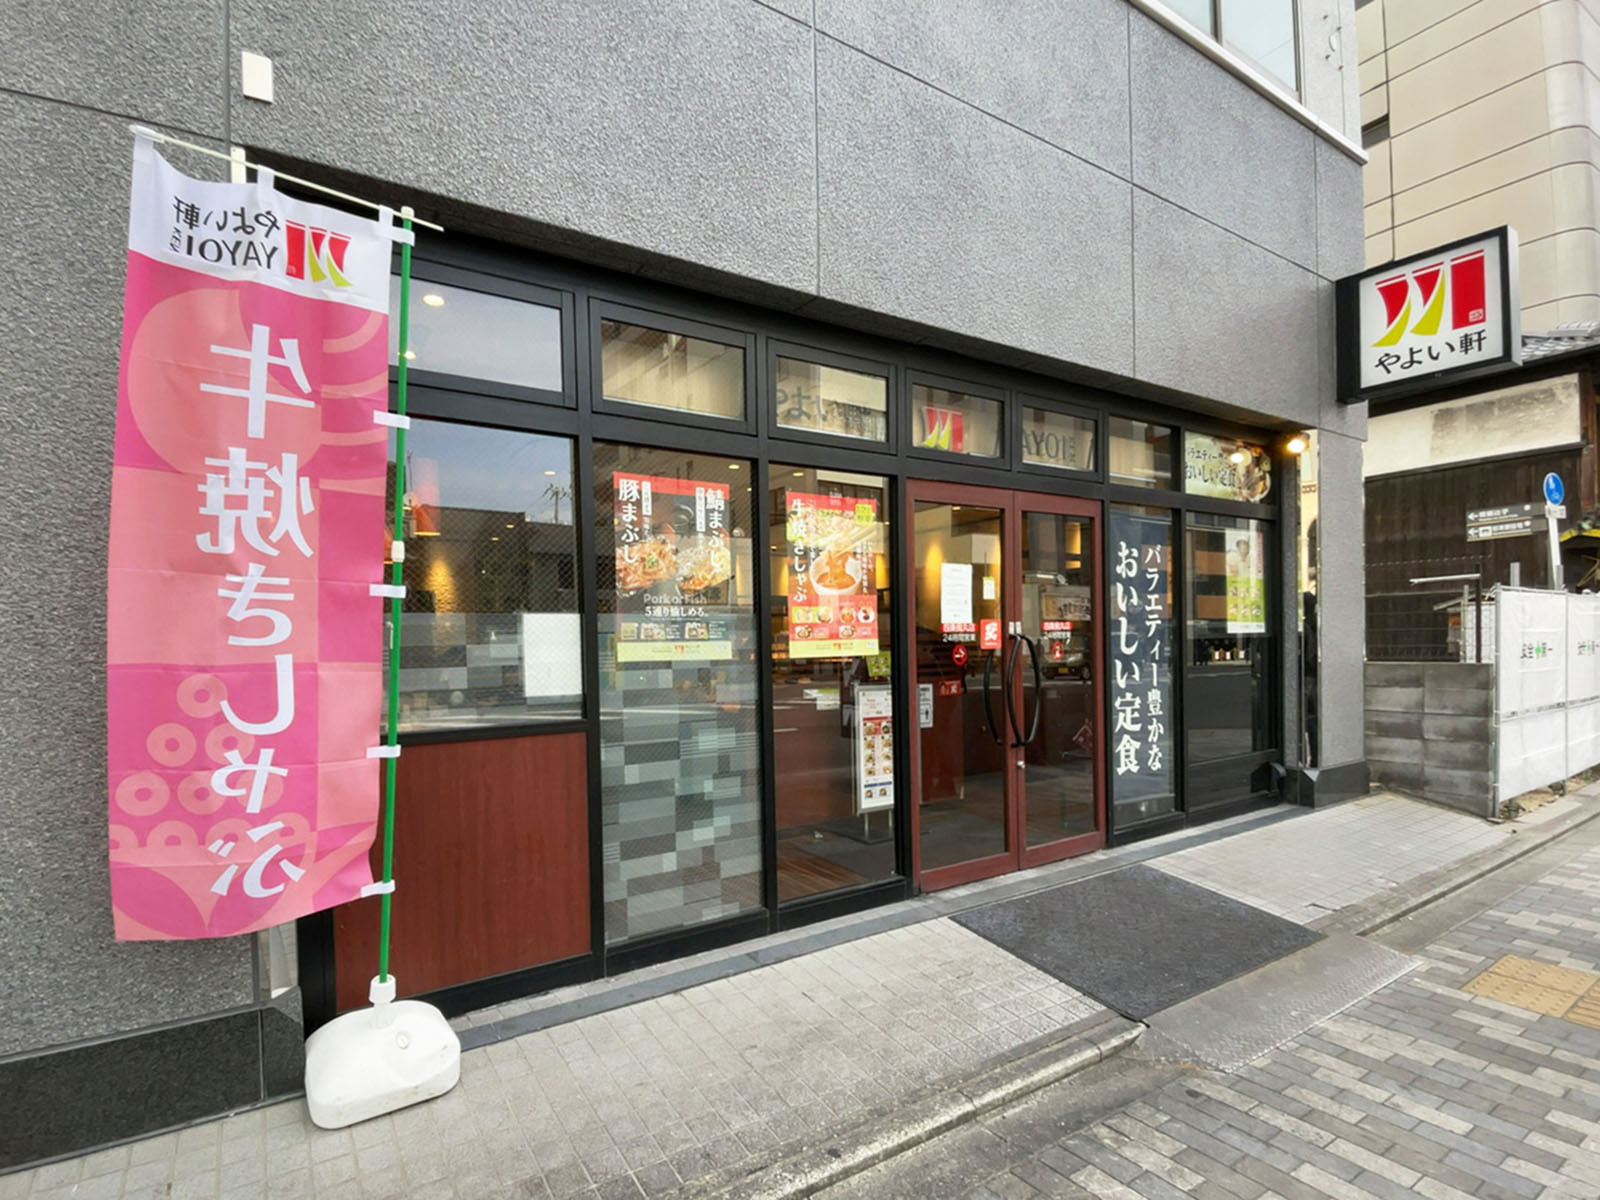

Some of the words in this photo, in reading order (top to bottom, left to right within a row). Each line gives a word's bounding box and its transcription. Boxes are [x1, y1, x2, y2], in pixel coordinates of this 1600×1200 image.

[1374, 329, 1487, 375] やよい軒
[618, 479, 641, 564] 豚まぶし
[1114, 541, 1142, 776] おいしい定食
[1144, 544, 1164, 772] バラエティー豊かな
